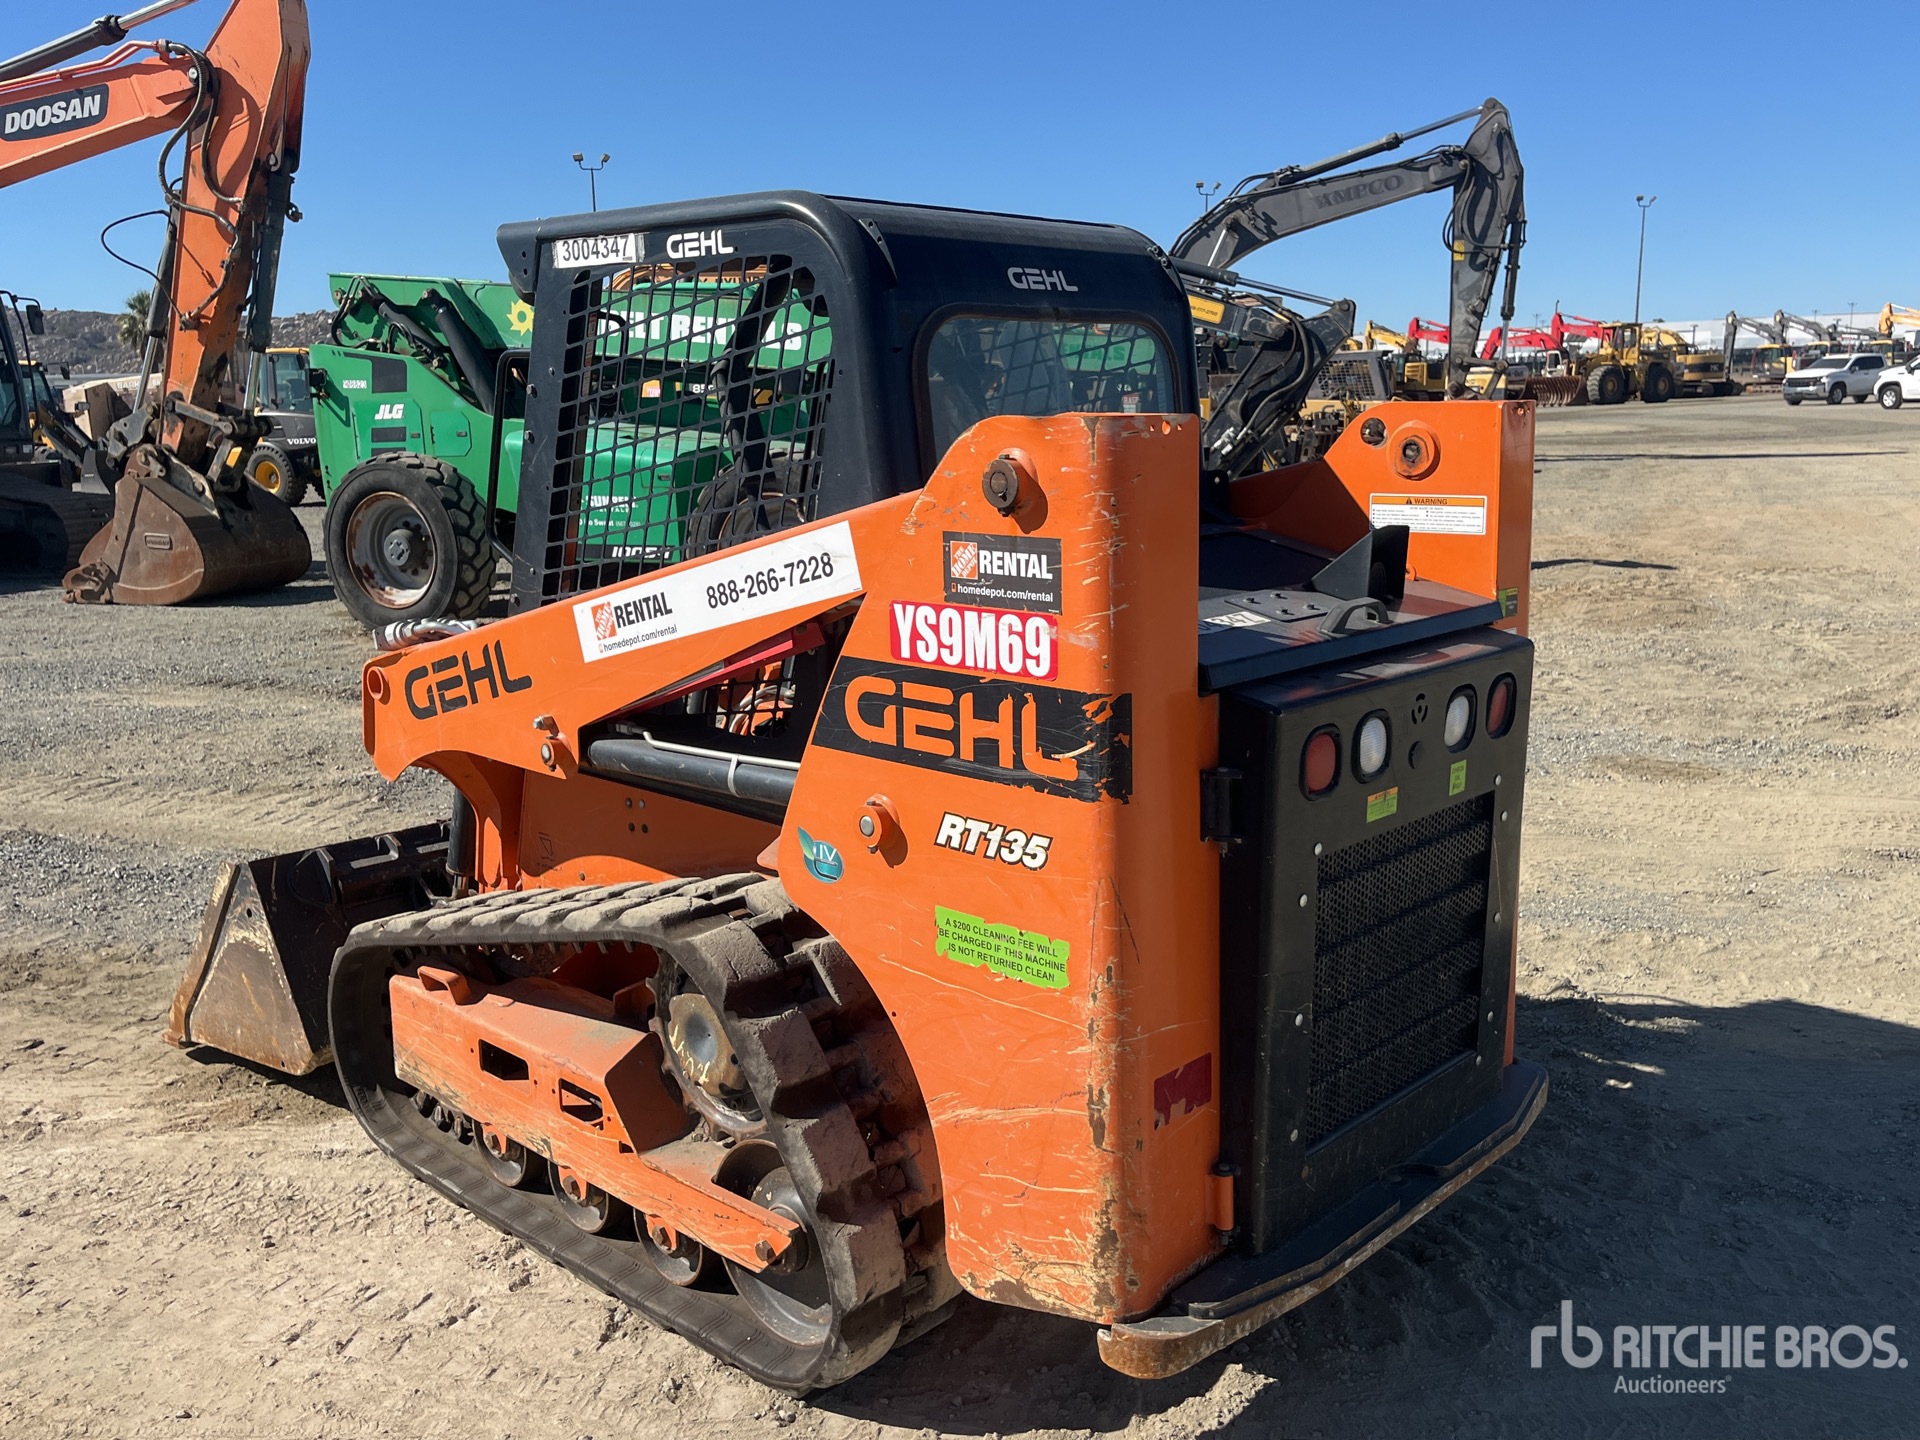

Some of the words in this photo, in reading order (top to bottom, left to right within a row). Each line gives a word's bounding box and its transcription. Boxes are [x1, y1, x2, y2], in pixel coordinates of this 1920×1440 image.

[4, 94, 101, 134] DOOSAN
[562, 234, 630, 262] 3004347
[666, 229, 734, 259] GEHL
[1007, 266, 1079, 292] GEHL
[669, 314, 803, 351] RENALS
[374, 403, 405, 420] JLG
[286, 437, 317, 446] VOLVO
[951, 544, 977, 578] HOME
[953, 545, 965, 560] THE
[961, 556, 977, 578] DEPOT
[979, 549, 1053, 580] RENTAL
[706, 552, 834, 609] 888-266-7228
[957, 583, 1054, 602] homedepot.com/rental
[596, 602, 613, 639] HOME
[614, 591, 673, 629] RENTAL
[603, 623, 678, 652] homedepot.com/rental
[893, 603, 1051, 678] YS9M69
[404, 639, 533, 720] GEHL
[844, 675, 1079, 782] GEHL
[934, 811, 1054, 871] RT135
[939, 927, 950, 939] BE
[952, 931, 993, 951] CHARGED
[994, 943, 1002, 953] IF
[1004, 946, 1024, 960] THIS
[1025, 952, 1066, 973] MACHINE
[945, 918, 952, 927] A
[953, 919, 971, 932] $200
[972, 925, 1016, 945] CLEANING
[1018, 938, 1035, 951] FEE
[1036, 943, 1059, 958] WILL
[948, 942, 957, 952] IS
[958, 945, 976, 958] NOT
[977, 952, 1023, 972] RETURNED
[1025, 966, 1055, 982] CLEAN
